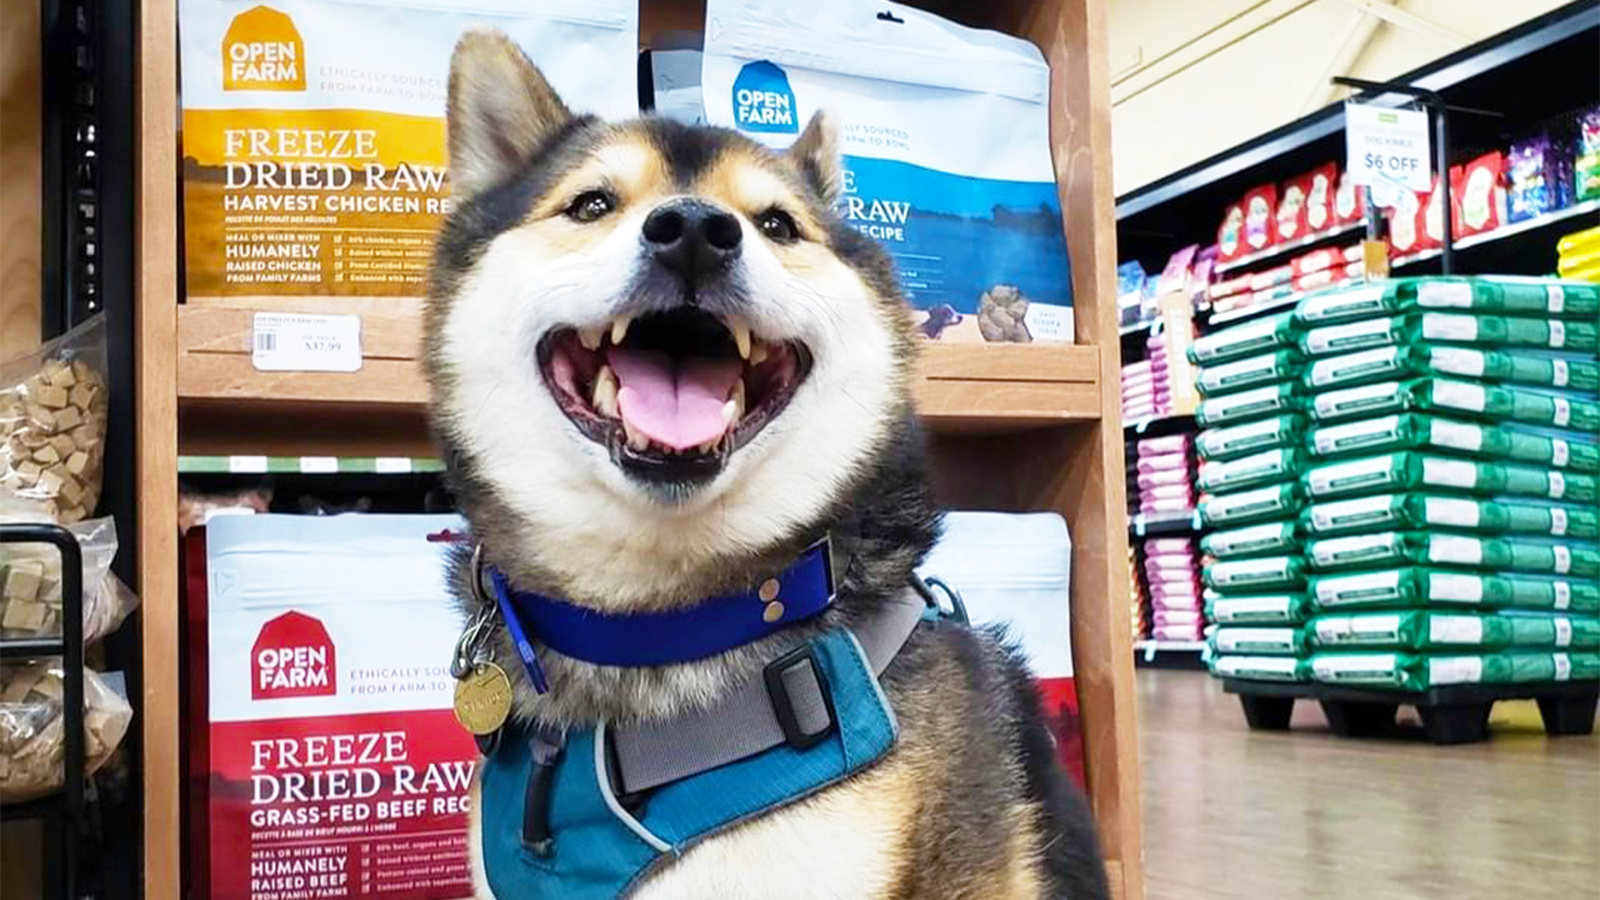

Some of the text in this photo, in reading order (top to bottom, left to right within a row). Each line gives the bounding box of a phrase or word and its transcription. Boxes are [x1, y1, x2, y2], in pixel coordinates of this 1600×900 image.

[229, 42, 295, 62] OPEN
[231, 63, 297, 81] FARM
[737, 89, 790, 109] OPEN
[738, 107, 792, 125] FARM
[224, 129, 379, 158] FREEZE
[1365, 153, 1419, 172] $6 OFF
[224, 161, 447, 193] DRIED RAW
[224, 194, 320, 211] HARVEST
[325, 195, 420, 213] CHICKEN
[847, 196, 911, 224] RAW
[226, 244, 320, 258] HUMANELY
[226, 260, 321, 271] RAISED CHICKEN
[226, 273, 321, 282] FROM FAMILY FARMS
[258, 645, 327, 668] OPEN
[260, 667, 328, 690] FARM
[350, 667, 420, 680] ETHICALLY
[350, 684, 388, 695] FROM
[251, 732, 407, 770] FREEZE
[251, 760, 476, 804] DRIED RAW
[251, 803, 370, 827] GRASS-FED
[377, 799, 427, 818] BEEF
[251, 850, 275, 859] MEAL
[277, 849, 291, 858] OR
[325, 845, 348, 854] WITH
[251, 856, 347, 877] HUMANELY
[251, 873, 348, 892] RAISED BEEF
[251, 887, 348, 900] FROM FAMILY FARMS
